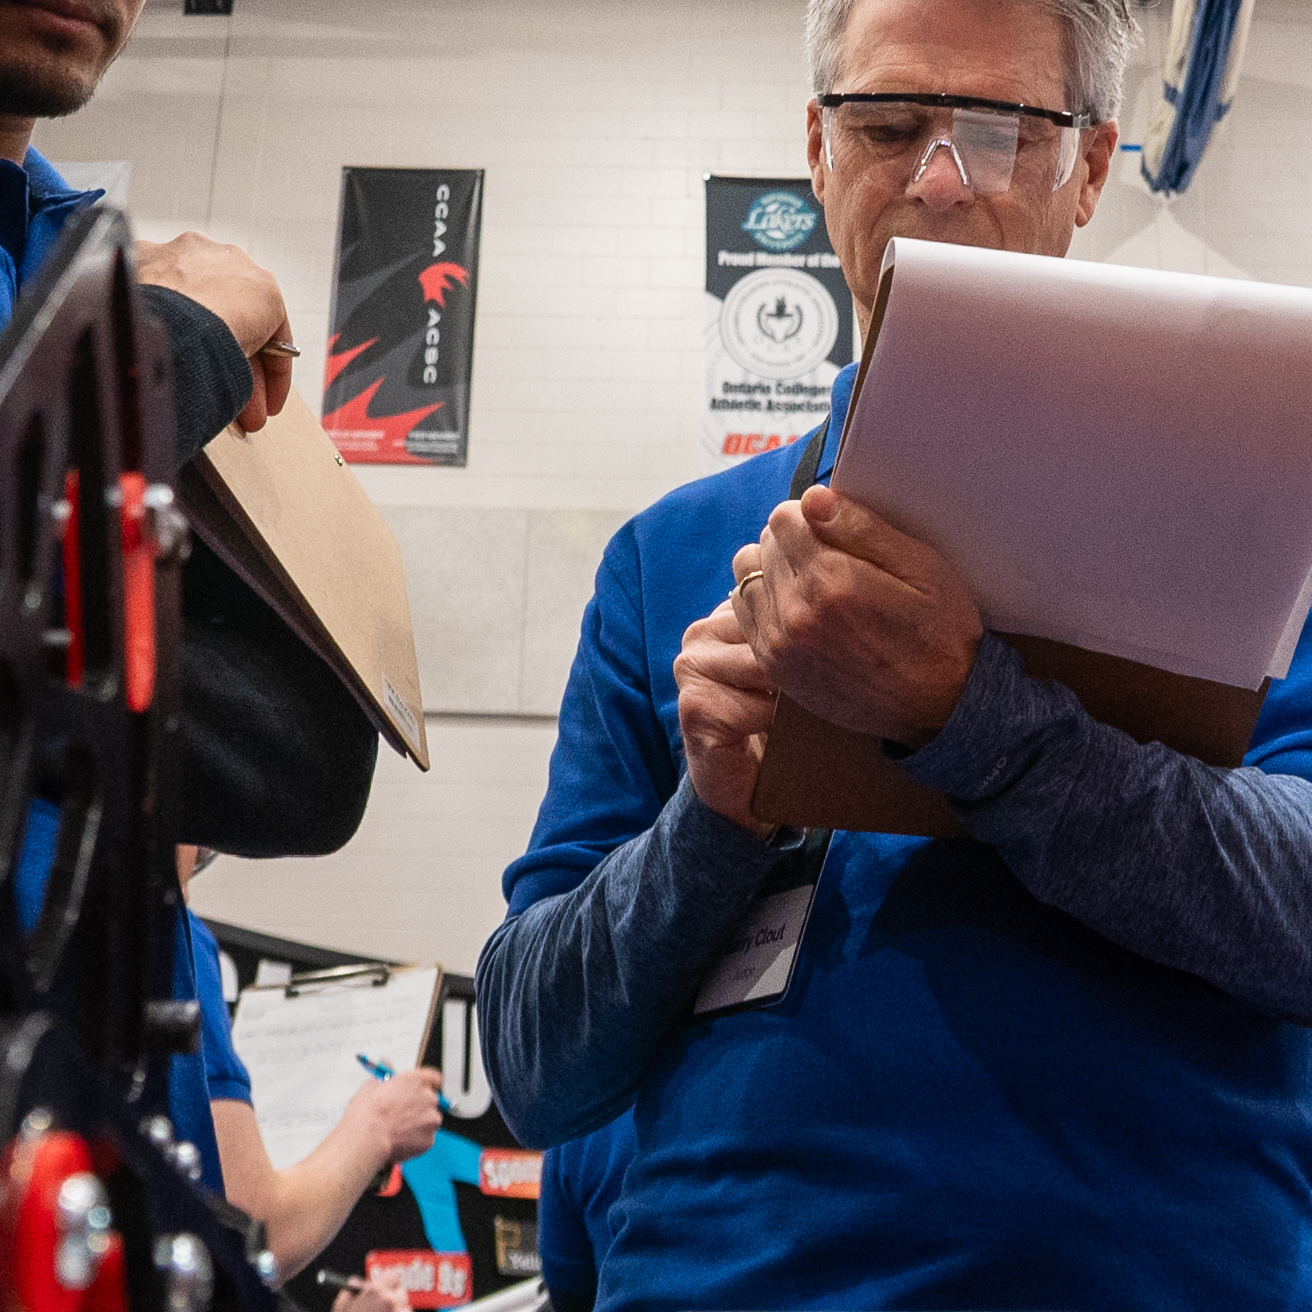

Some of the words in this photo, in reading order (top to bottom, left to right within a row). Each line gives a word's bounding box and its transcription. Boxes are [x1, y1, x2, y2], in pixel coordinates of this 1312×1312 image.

[432, 183, 450, 257] CCAA
[422, 308, 441, 385] ACSC
[722, 381, 771, 395] Ontario
[755, 923, 787, 947] Clout
